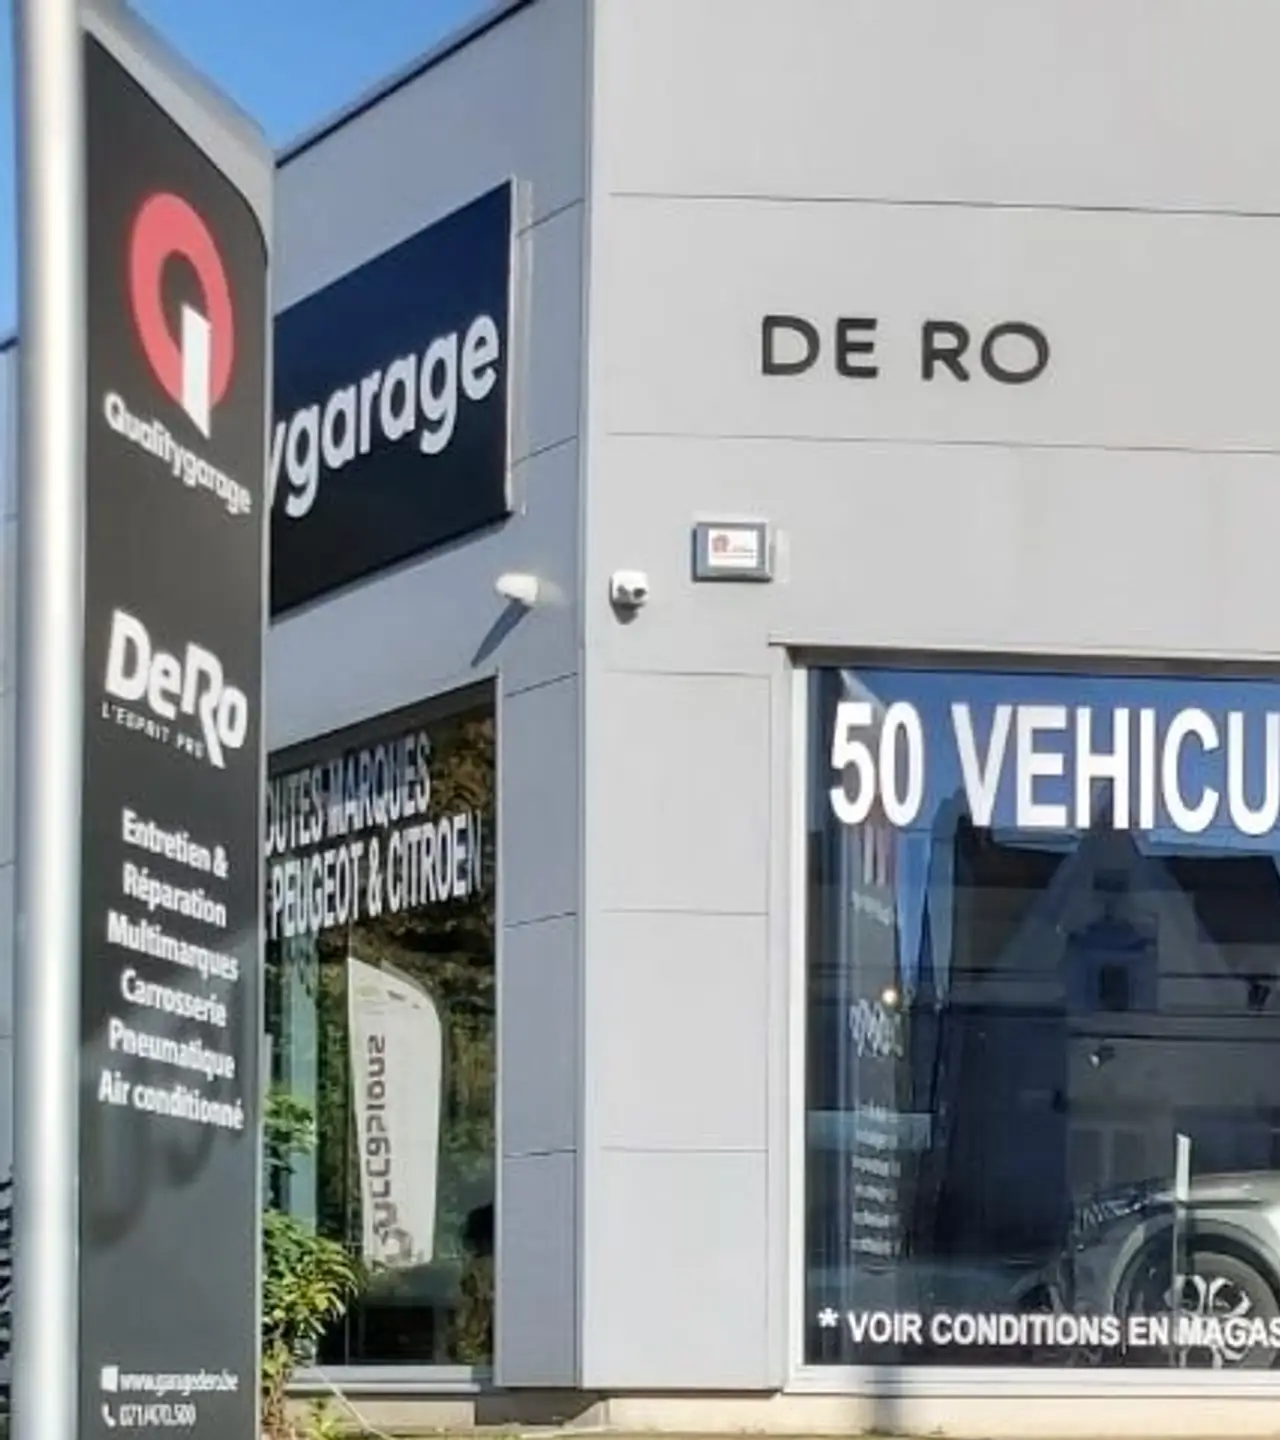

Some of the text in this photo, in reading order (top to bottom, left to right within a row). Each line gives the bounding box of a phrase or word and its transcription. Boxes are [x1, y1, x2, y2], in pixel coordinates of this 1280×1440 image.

[762, 314, 1049, 385] DE RO
[104, 392, 251, 515] Qualitygarage
[105, 608, 248, 770] DeRo
[327, 731, 431, 838] MARQUES
[829, 701, 925, 827] 50
[122, 807, 229, 880] Entretien &
[271, 808, 482, 940] PEUGEOT & CITROEN
[122, 861, 227, 929] Réparation
[107, 909, 239, 981] Multimarques
[120, 968, 227, 1027] Carrosserie
[108, 1017, 236, 1082] Pneumatique
[98, 1069, 245, 1130] Air conditionné
[847, 1312, 922, 1345] VOIR
[930, 1312, 1121, 1347] CONDITIONS
[1128, 1315, 1173, 1347] EN
